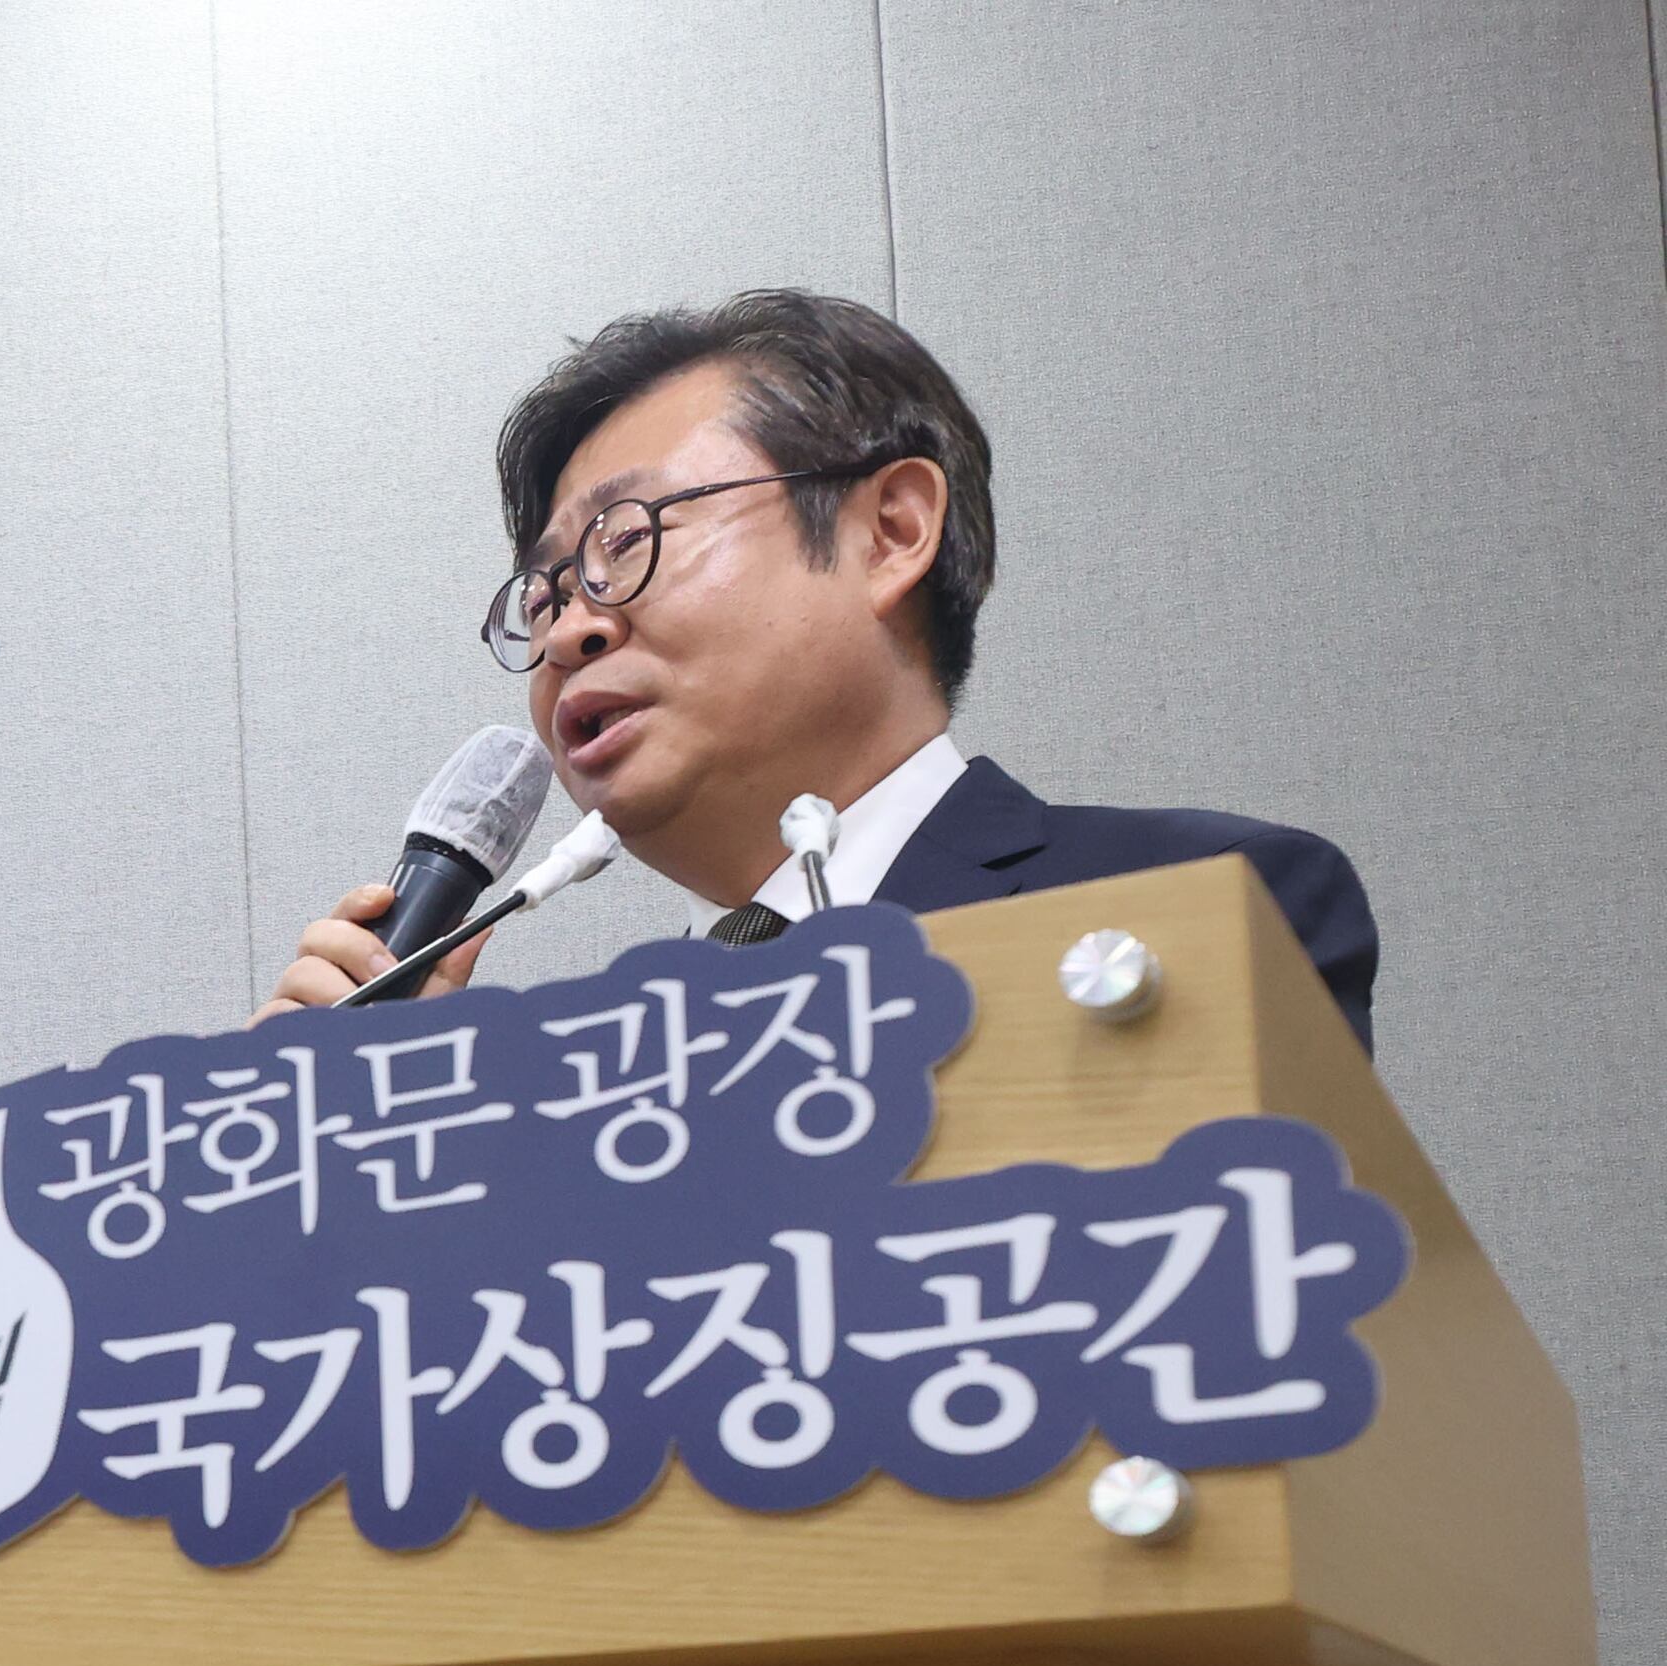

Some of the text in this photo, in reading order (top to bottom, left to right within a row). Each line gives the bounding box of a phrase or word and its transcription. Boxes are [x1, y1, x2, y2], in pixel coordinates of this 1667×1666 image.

[39, 944, 917, 1260] 광화문 광장
[75, 1168, 1357, 1530] 국가상징공간
